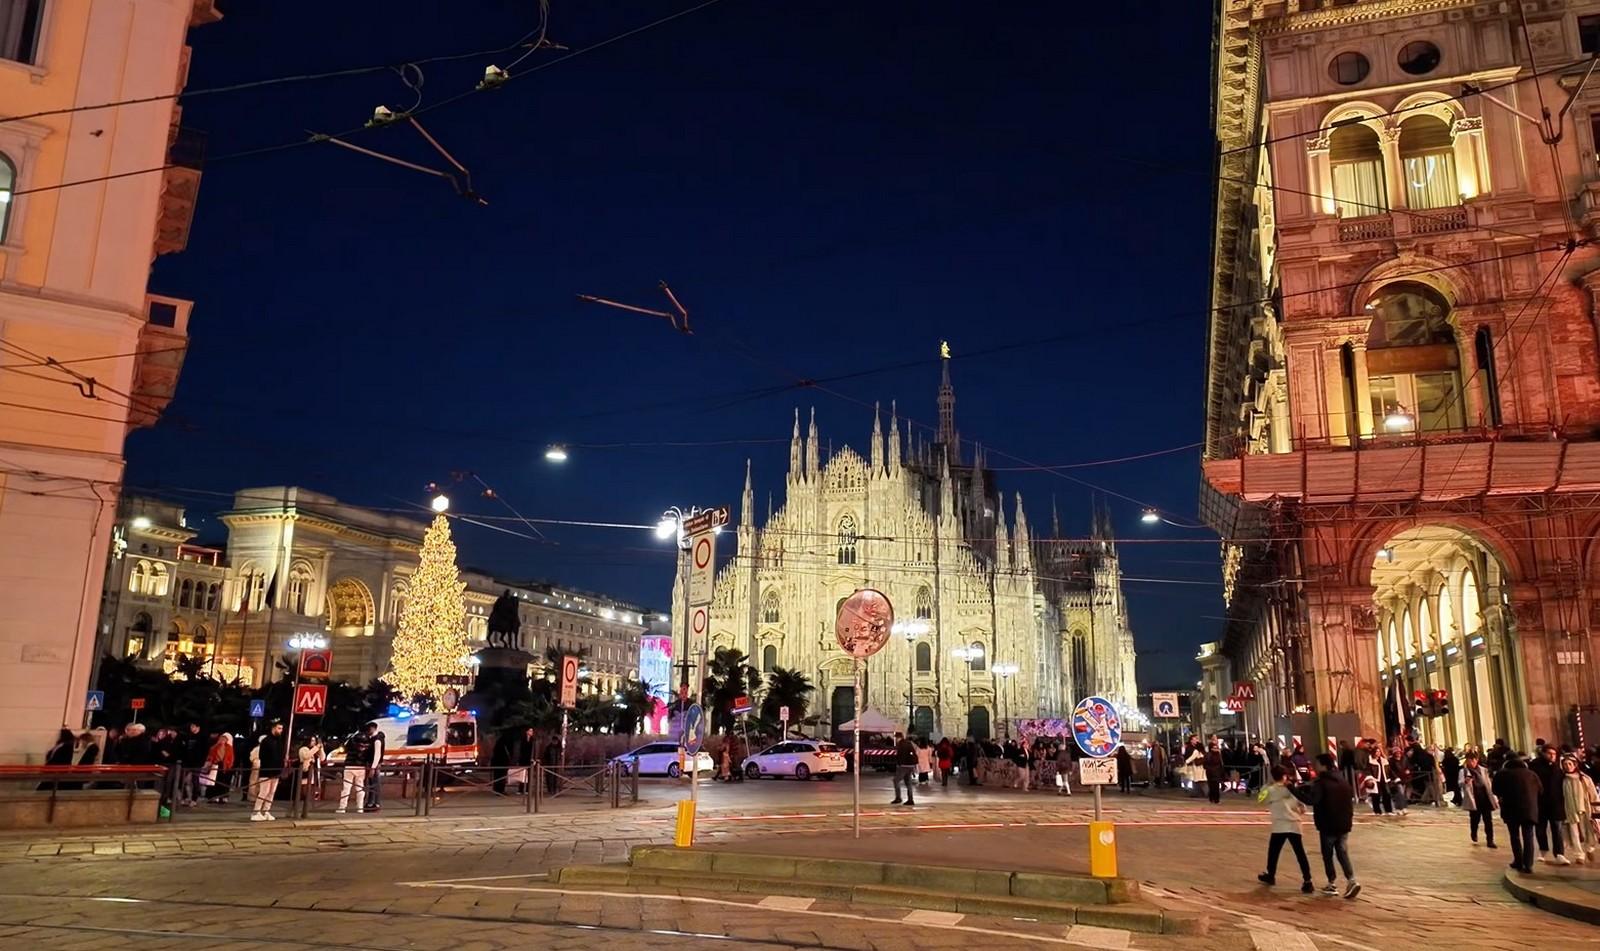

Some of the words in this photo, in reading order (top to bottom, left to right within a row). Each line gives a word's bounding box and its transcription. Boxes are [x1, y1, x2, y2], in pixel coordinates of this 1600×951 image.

[1238, 686, 1255, 698] M
[299, 691, 323, 708] M
[1229, 699, 1242, 708] M
